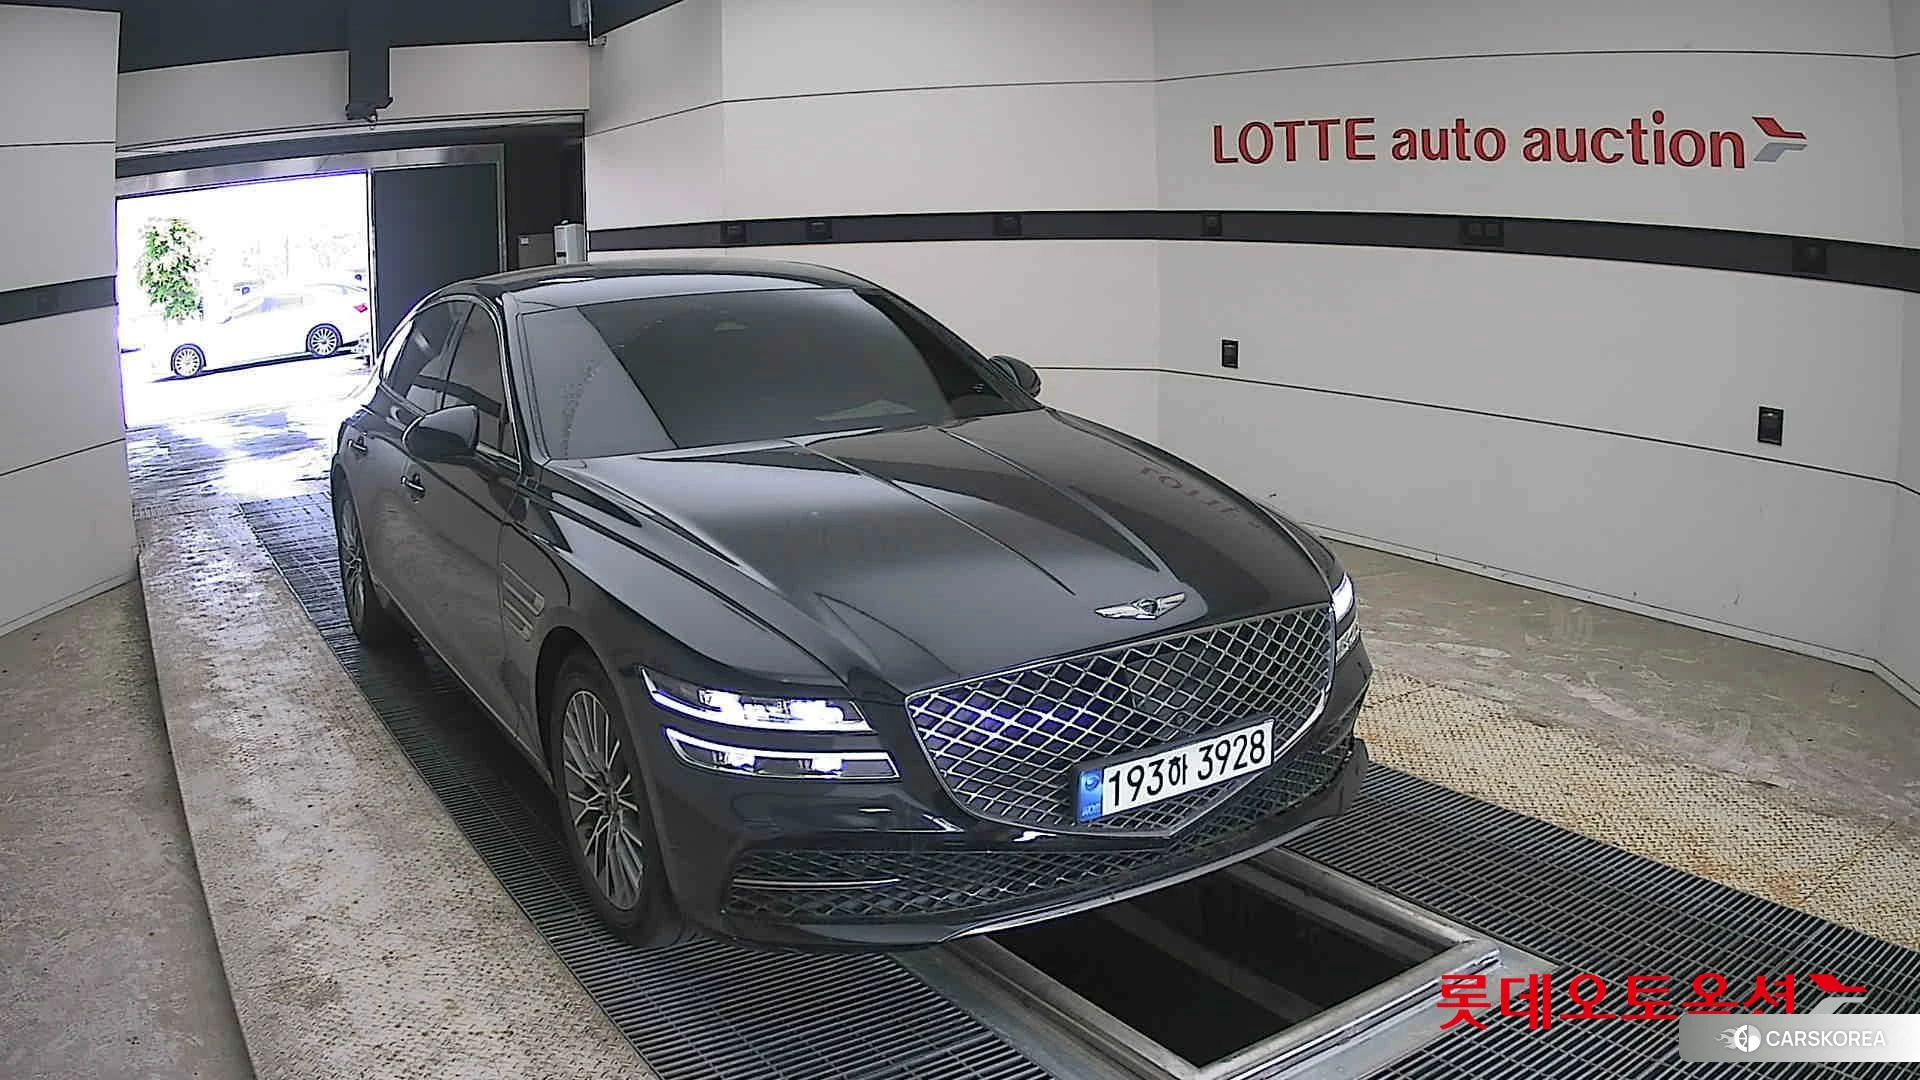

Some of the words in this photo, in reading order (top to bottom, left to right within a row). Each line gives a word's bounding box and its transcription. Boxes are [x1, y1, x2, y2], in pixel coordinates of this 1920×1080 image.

[1212, 117, 1377, 165] LOTTE
[1390, 118, 1507, 162] auto
[1521, 110, 1745, 169] auction
[1108, 754, 1188, 808] 193하
[1197, 729, 1265, 780] 3928
